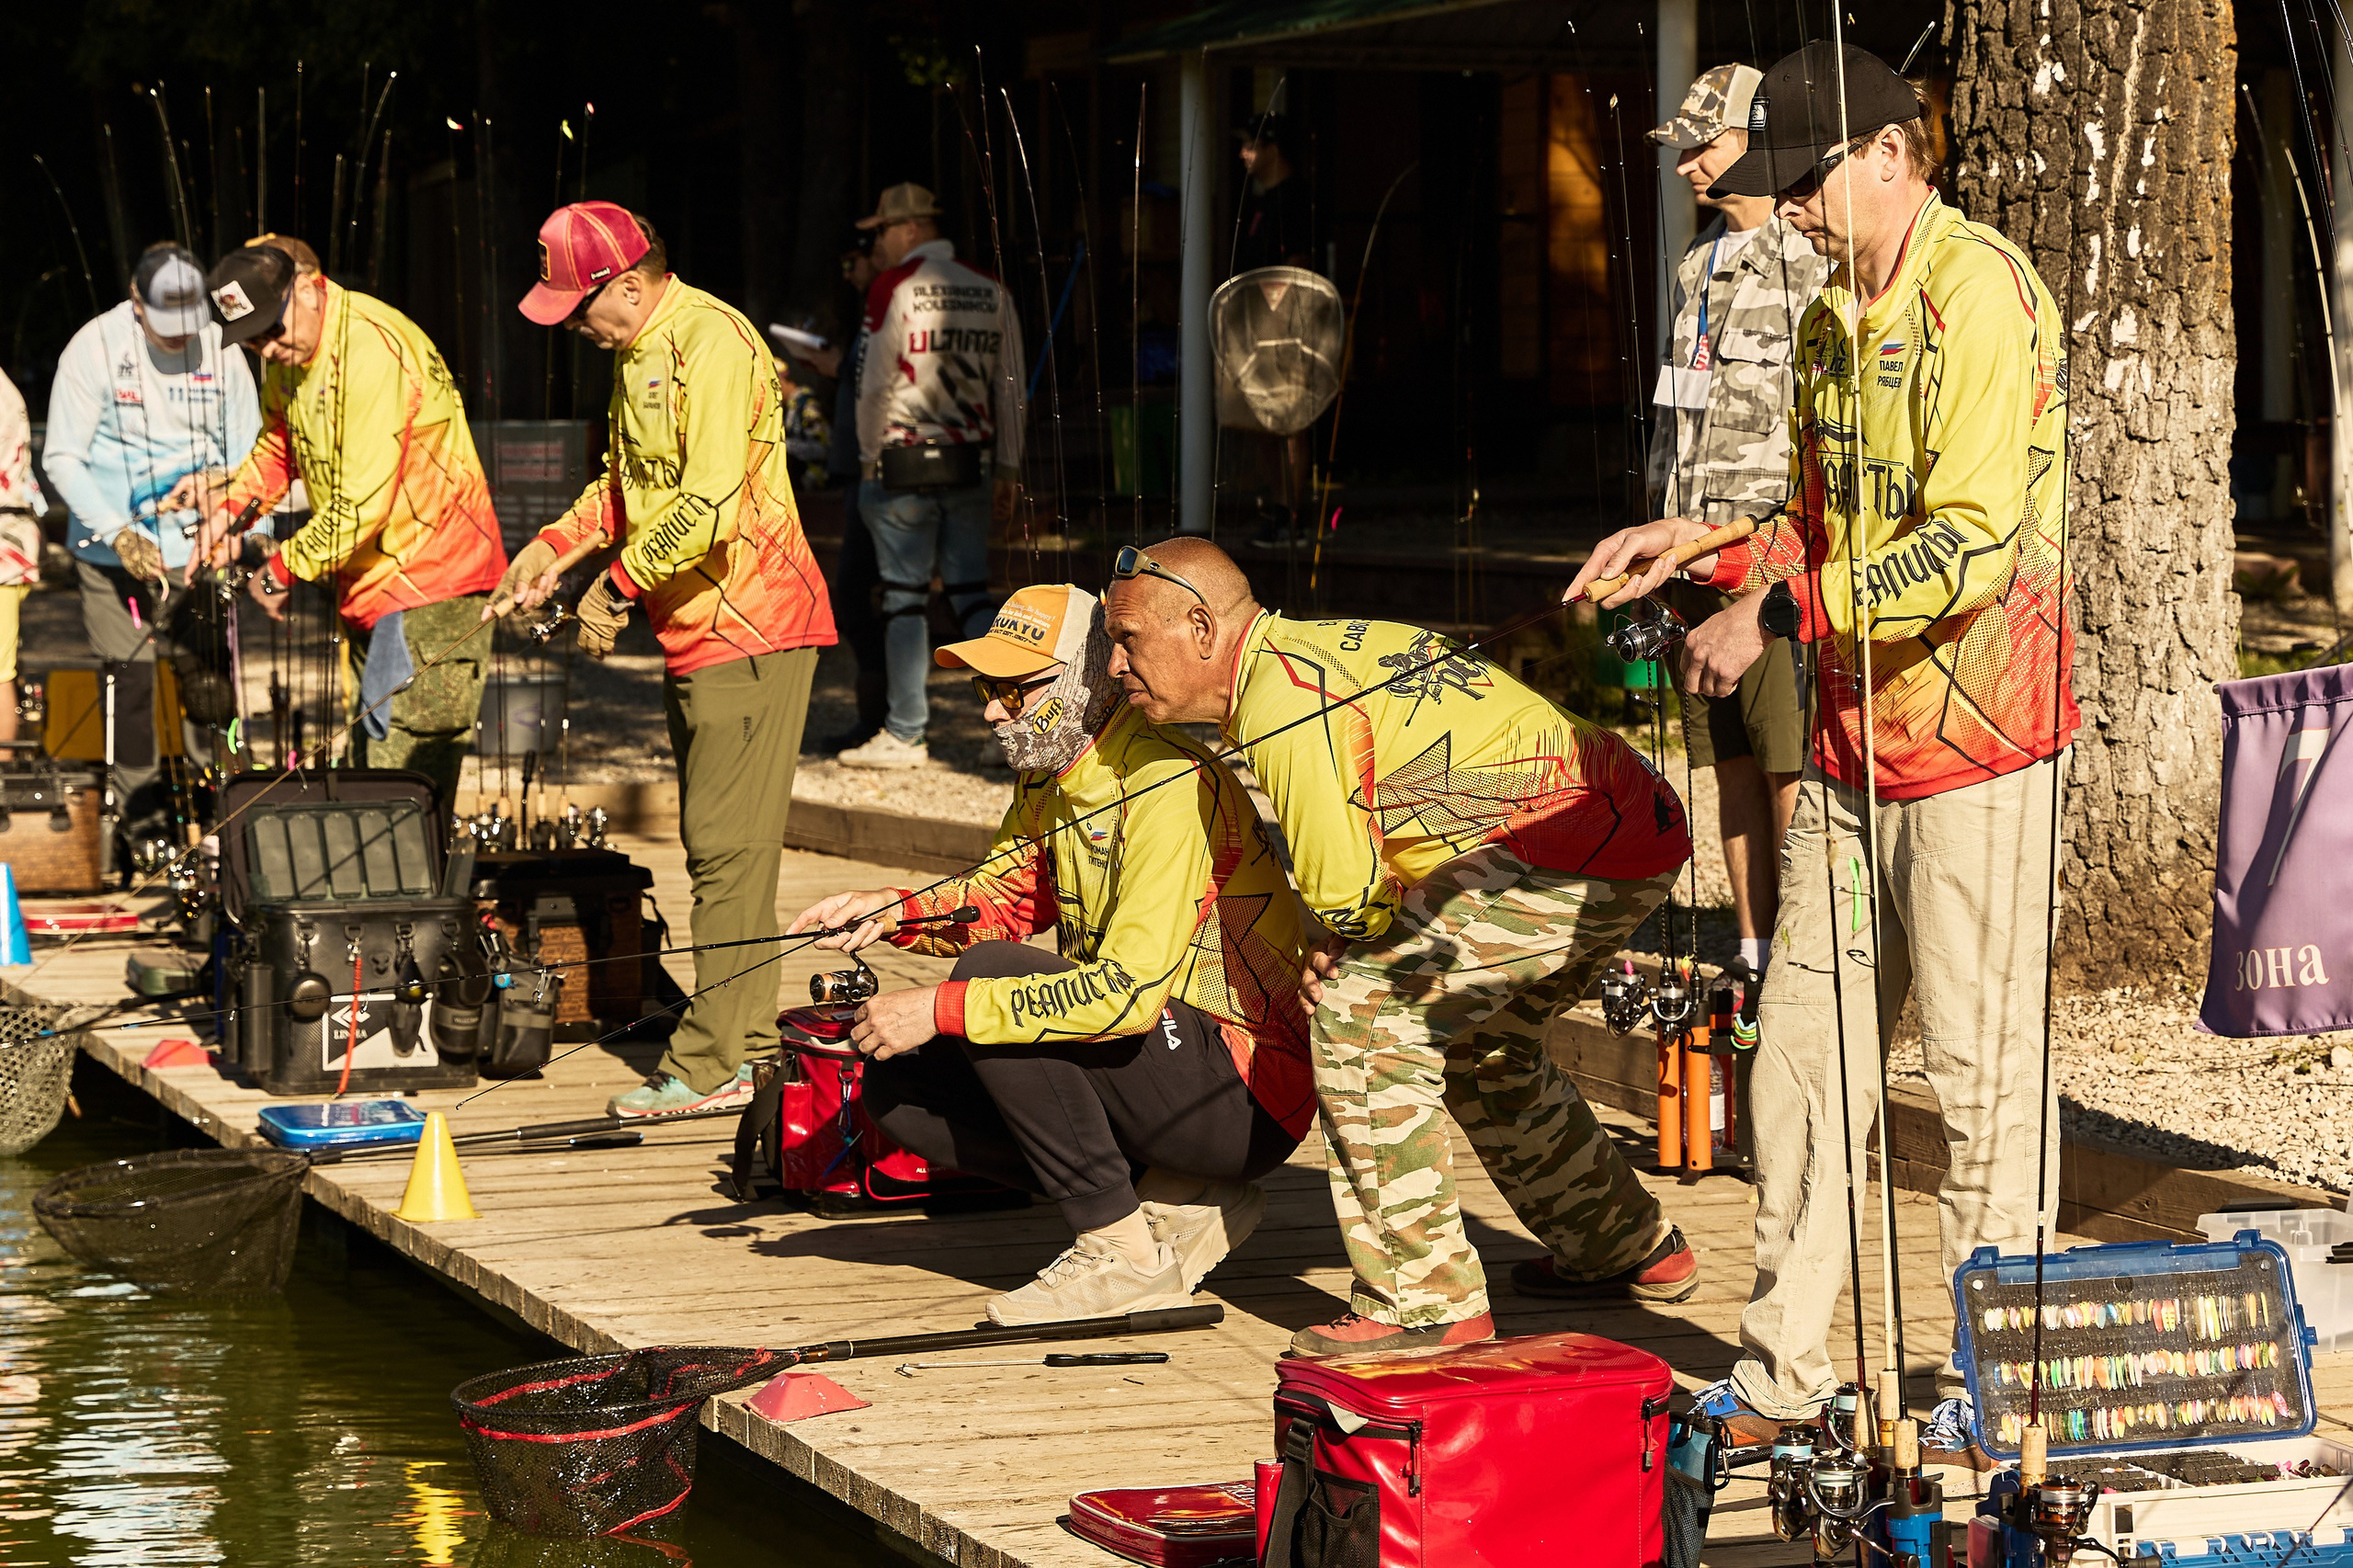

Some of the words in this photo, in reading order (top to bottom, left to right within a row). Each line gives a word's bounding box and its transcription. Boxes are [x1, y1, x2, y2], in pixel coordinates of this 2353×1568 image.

[1879, 359, 1904, 372] ПАВЕЛ
[1877, 375, 1903, 390] РЯБЦЕВ
[2268, 727, 2332, 887] 7
